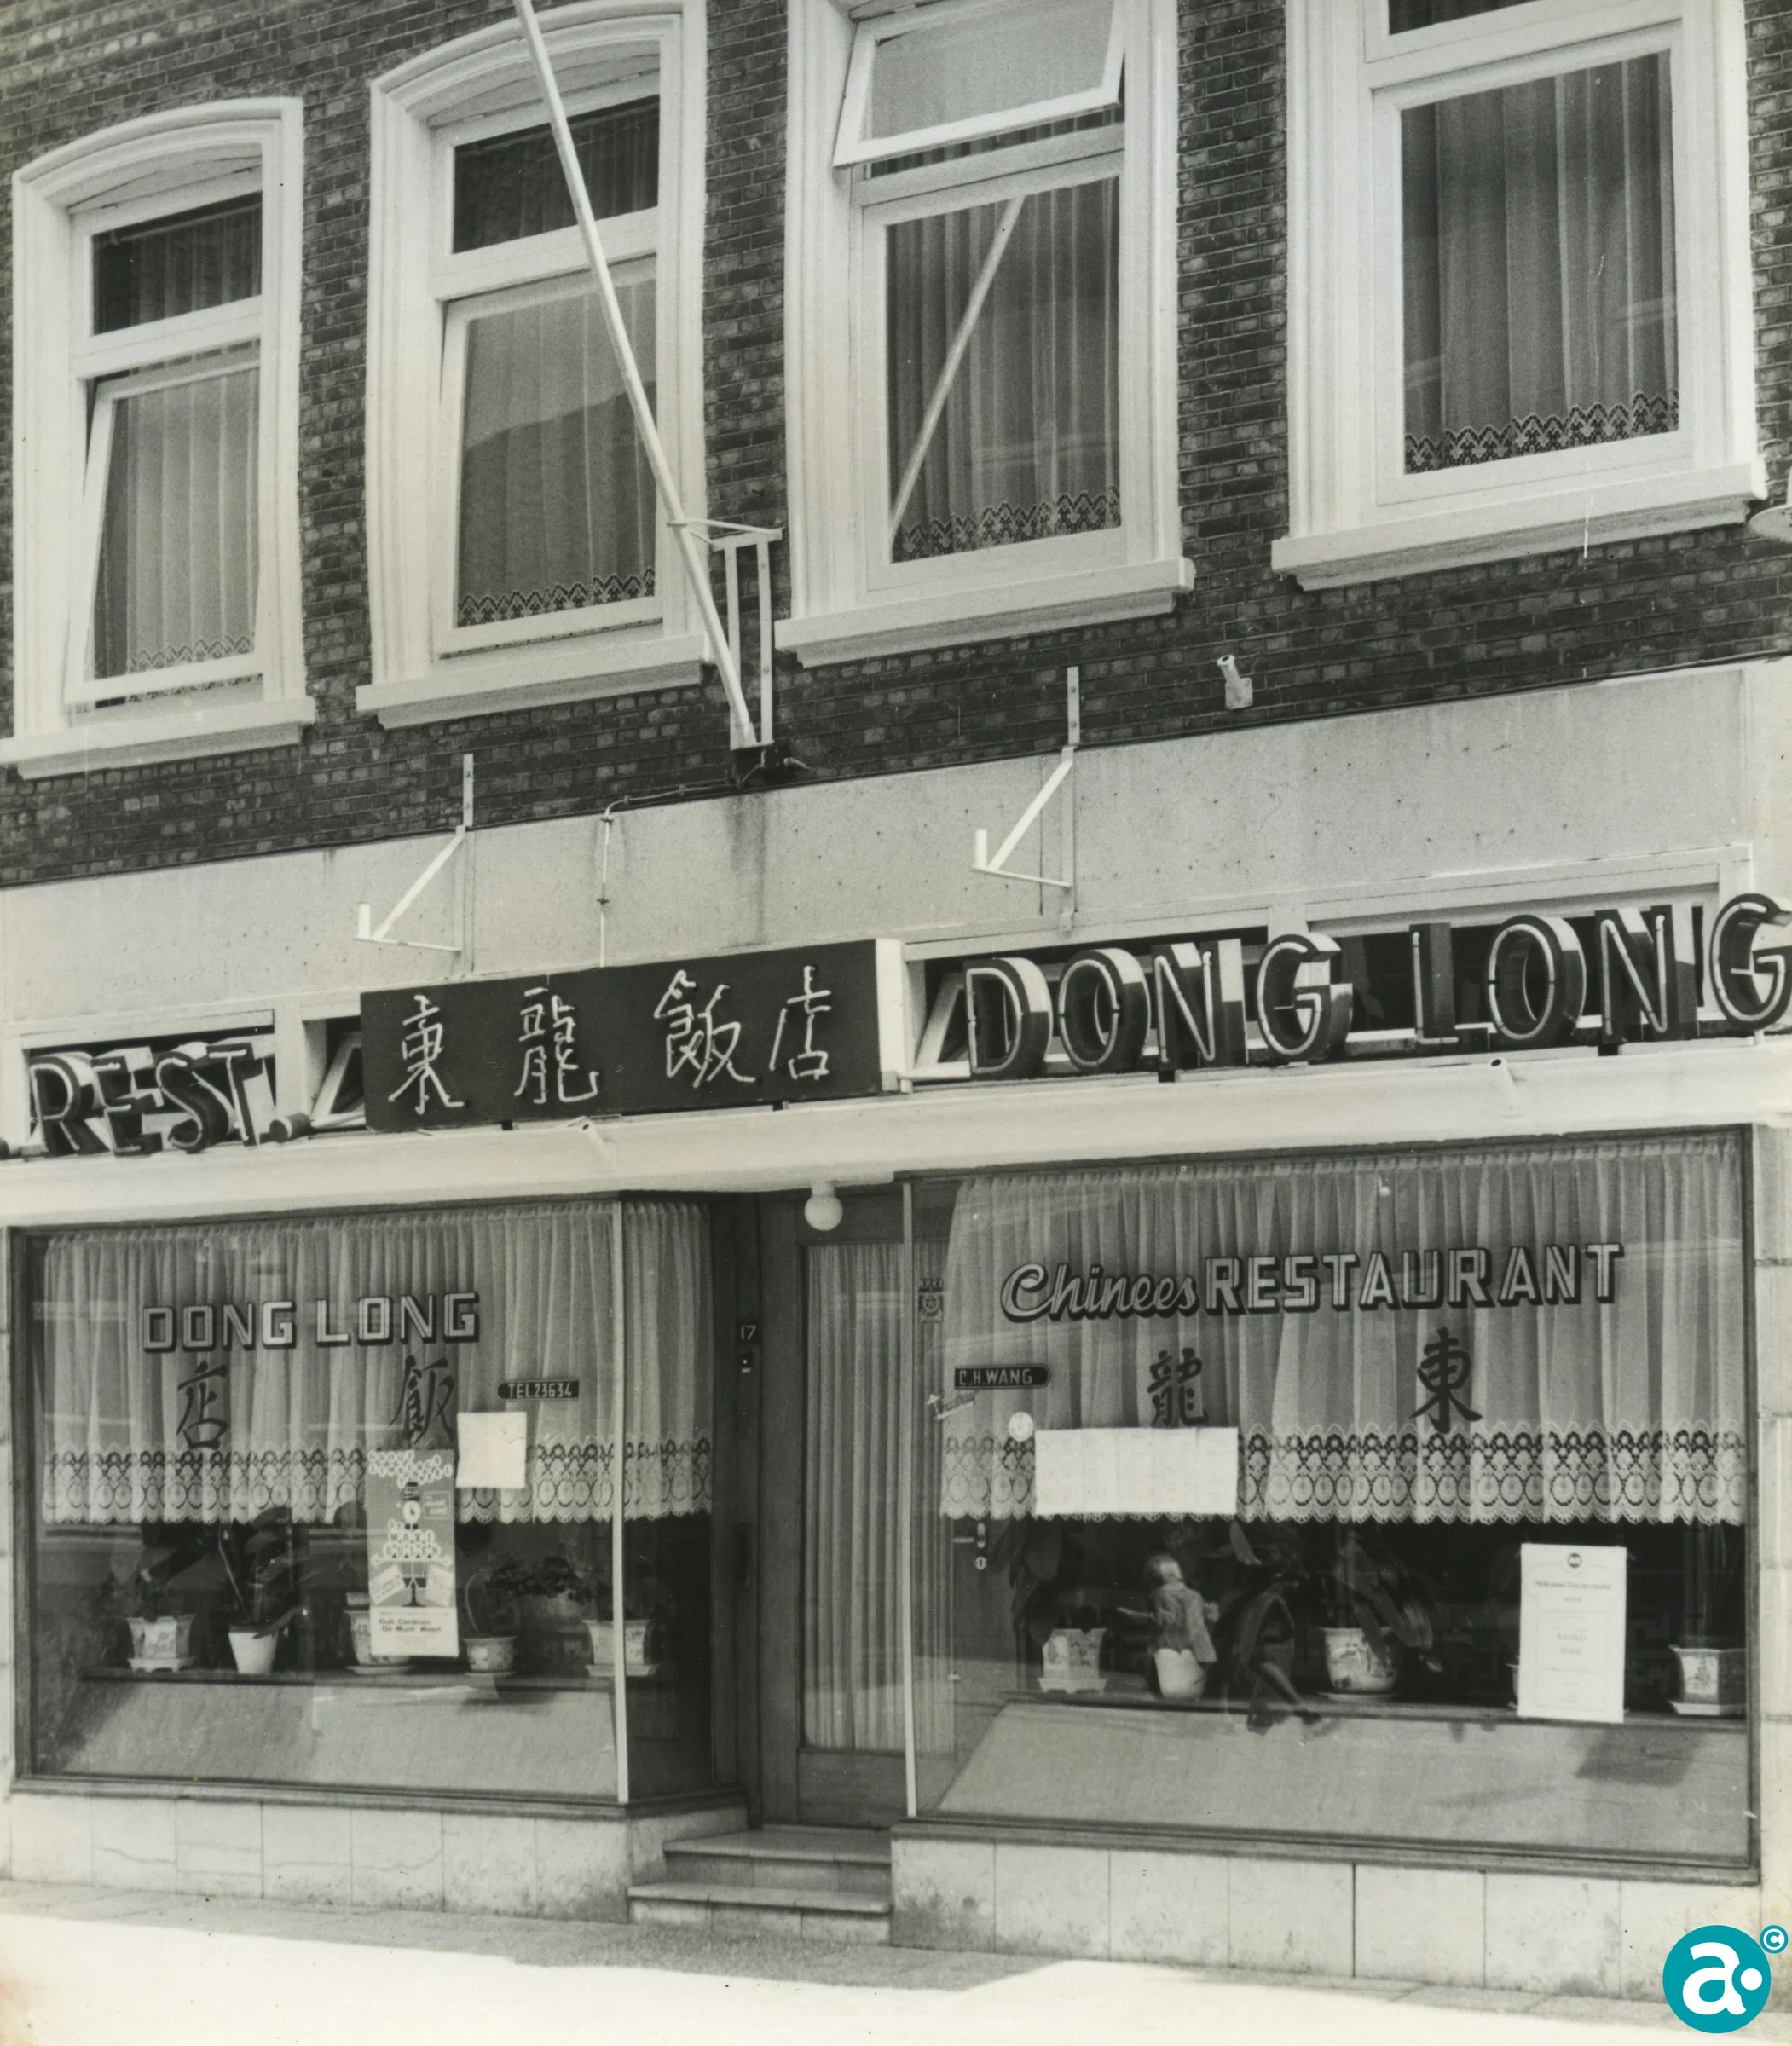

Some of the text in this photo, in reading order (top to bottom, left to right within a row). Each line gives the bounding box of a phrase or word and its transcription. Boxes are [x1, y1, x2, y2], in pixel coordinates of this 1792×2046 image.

[964, 893, 1792, 1080] DONG LONG
[389, 966, 835, 1115] 東龍飯店
[143, 1292, 479, 1352] DONG LONG
[1000, 1242, 1624, 1322] Chinees RESTAURANT
[741, 1326, 757, 1341] 17
[176, 1355, 456, 1449] 店 飯
[1147, 1326, 1483, 1434] 龍 東
[389, 1529, 435, 1543] MAXI
